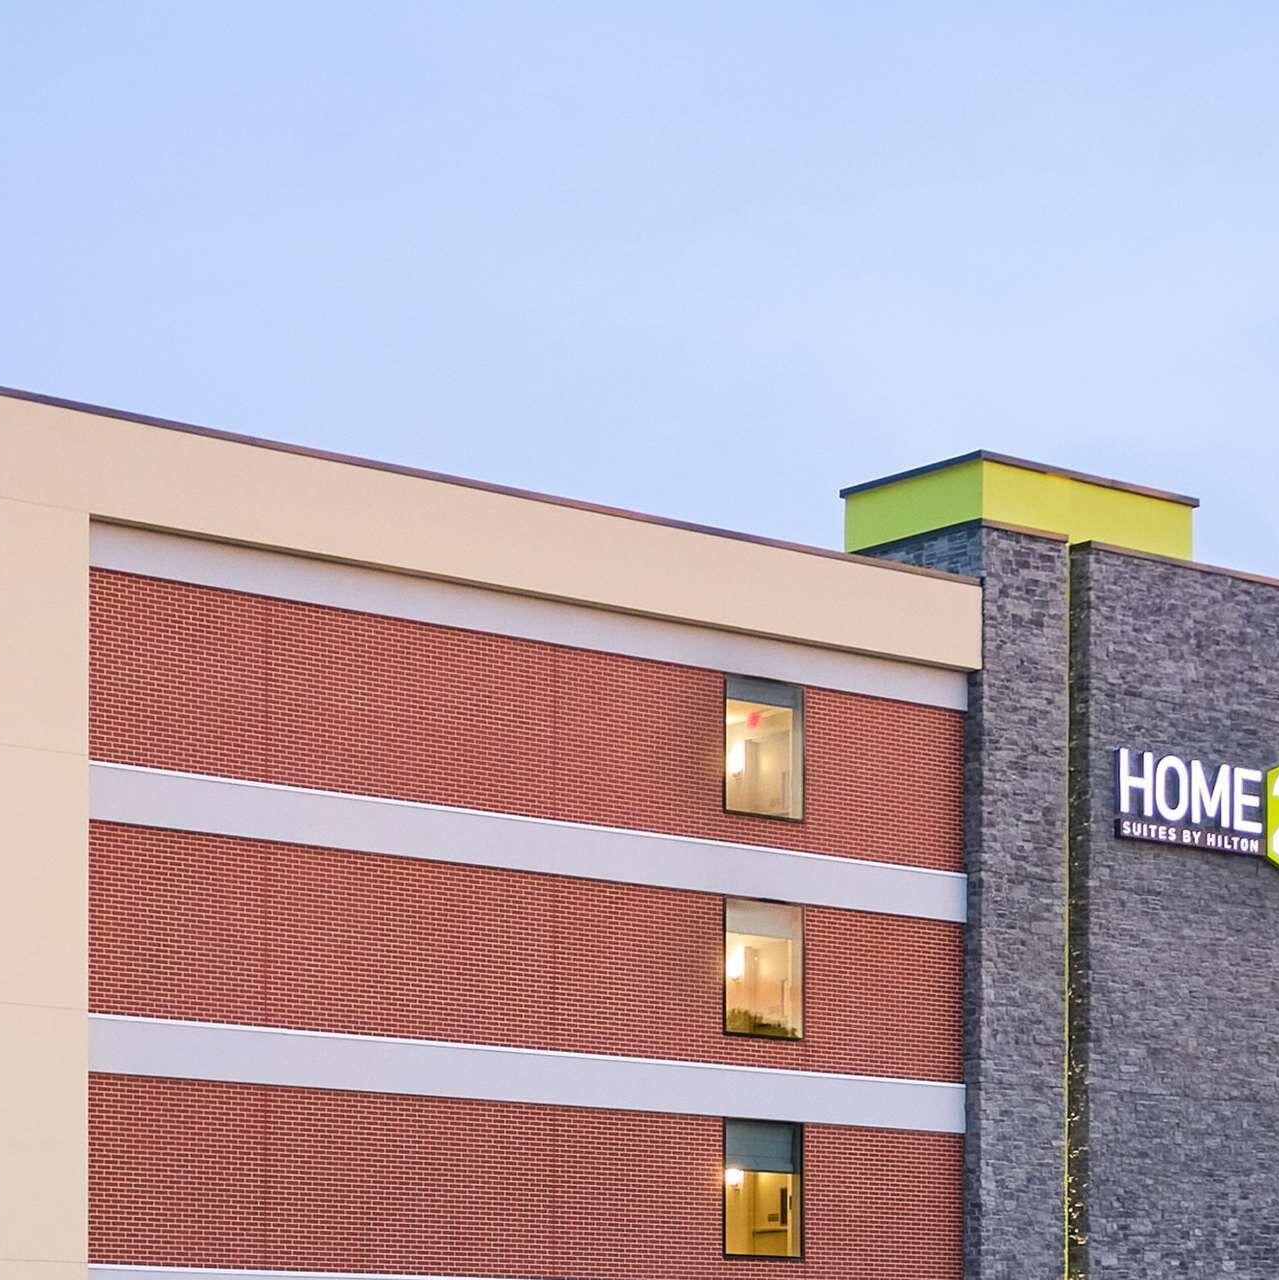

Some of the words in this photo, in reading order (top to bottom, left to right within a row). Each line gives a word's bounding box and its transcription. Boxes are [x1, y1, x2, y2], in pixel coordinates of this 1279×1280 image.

[1122, 821, 1176, 842] SUITES
[1182, 829, 1201, 845] BY
[1206, 832, 1260, 854] HILTON
